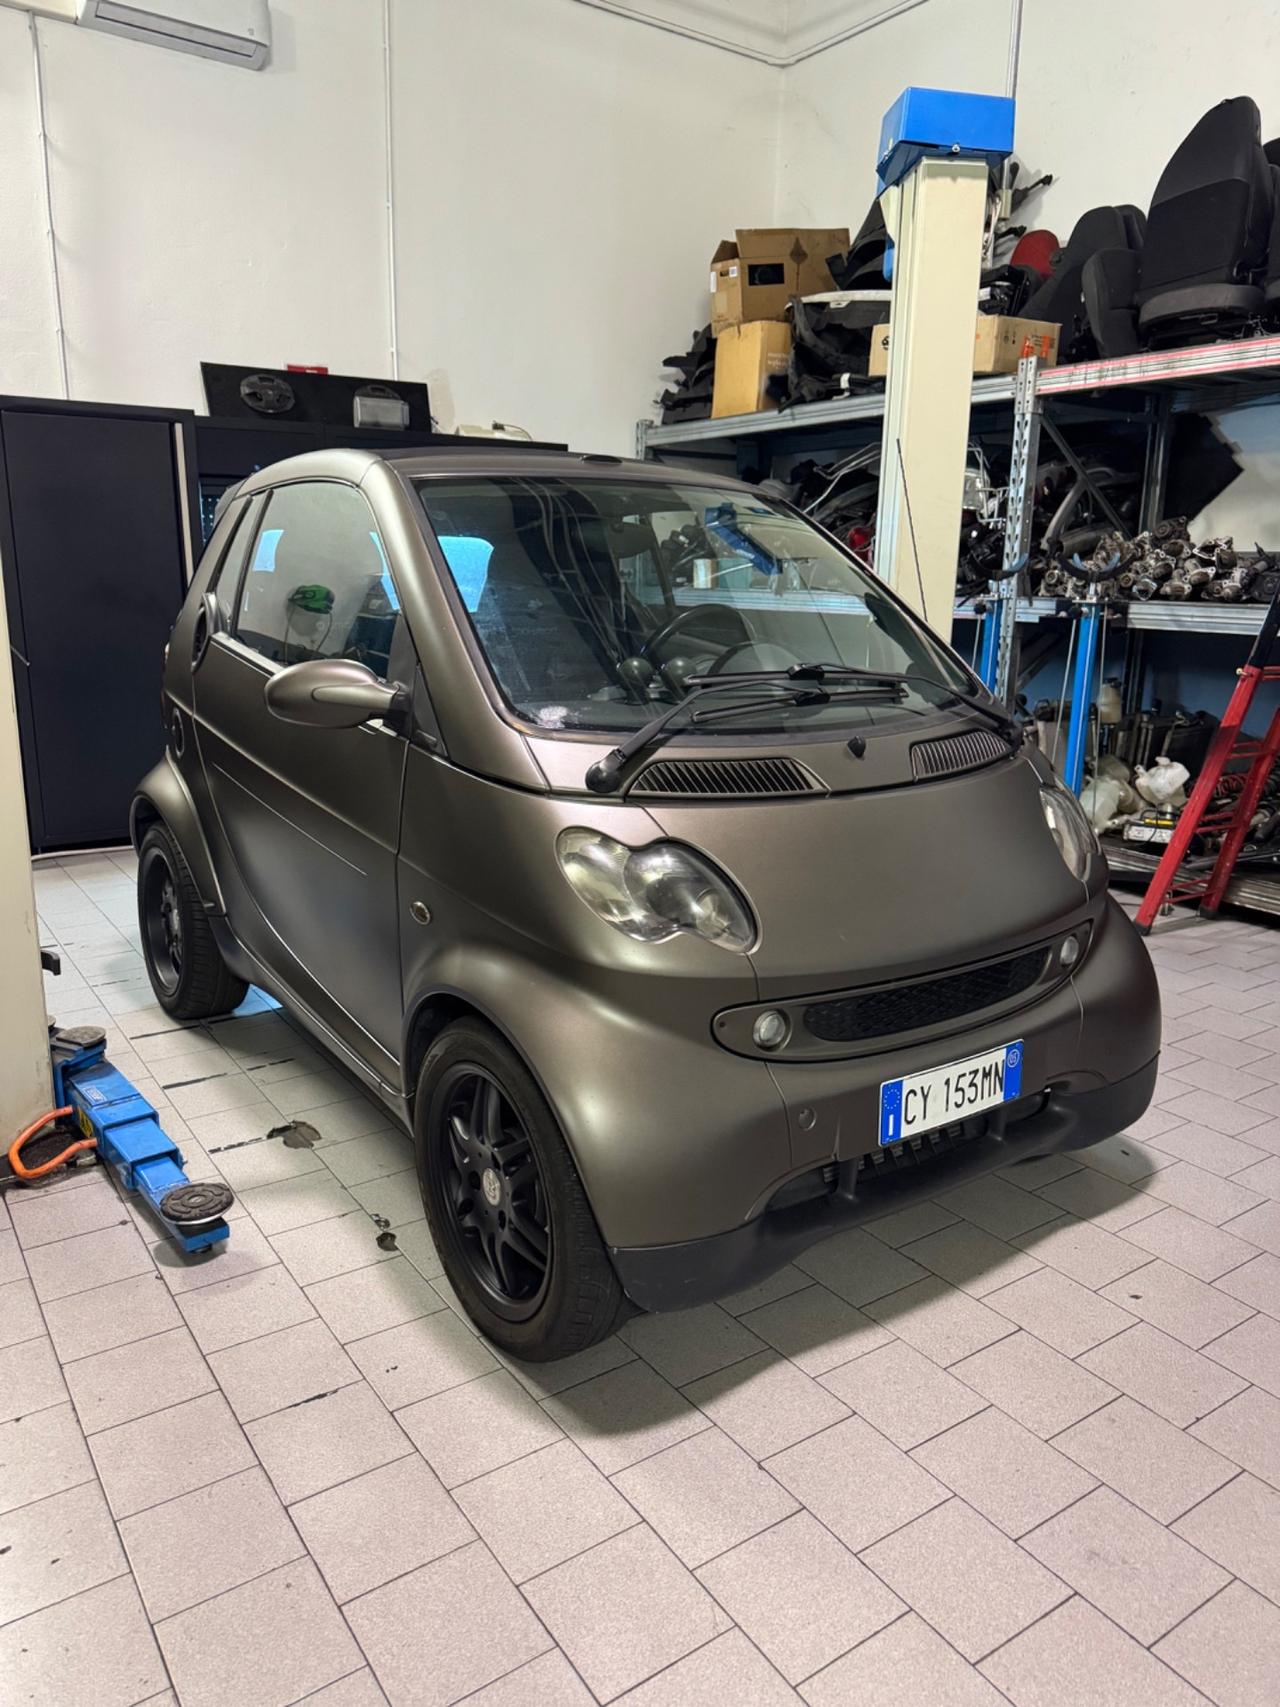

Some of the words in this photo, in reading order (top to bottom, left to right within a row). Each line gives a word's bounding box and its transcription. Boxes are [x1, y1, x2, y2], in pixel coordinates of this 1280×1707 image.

[904, 1084, 931, 1125] CY
[944, 1059, 1005, 1112] 153MN
[888, 1114, 894, 1136] I
